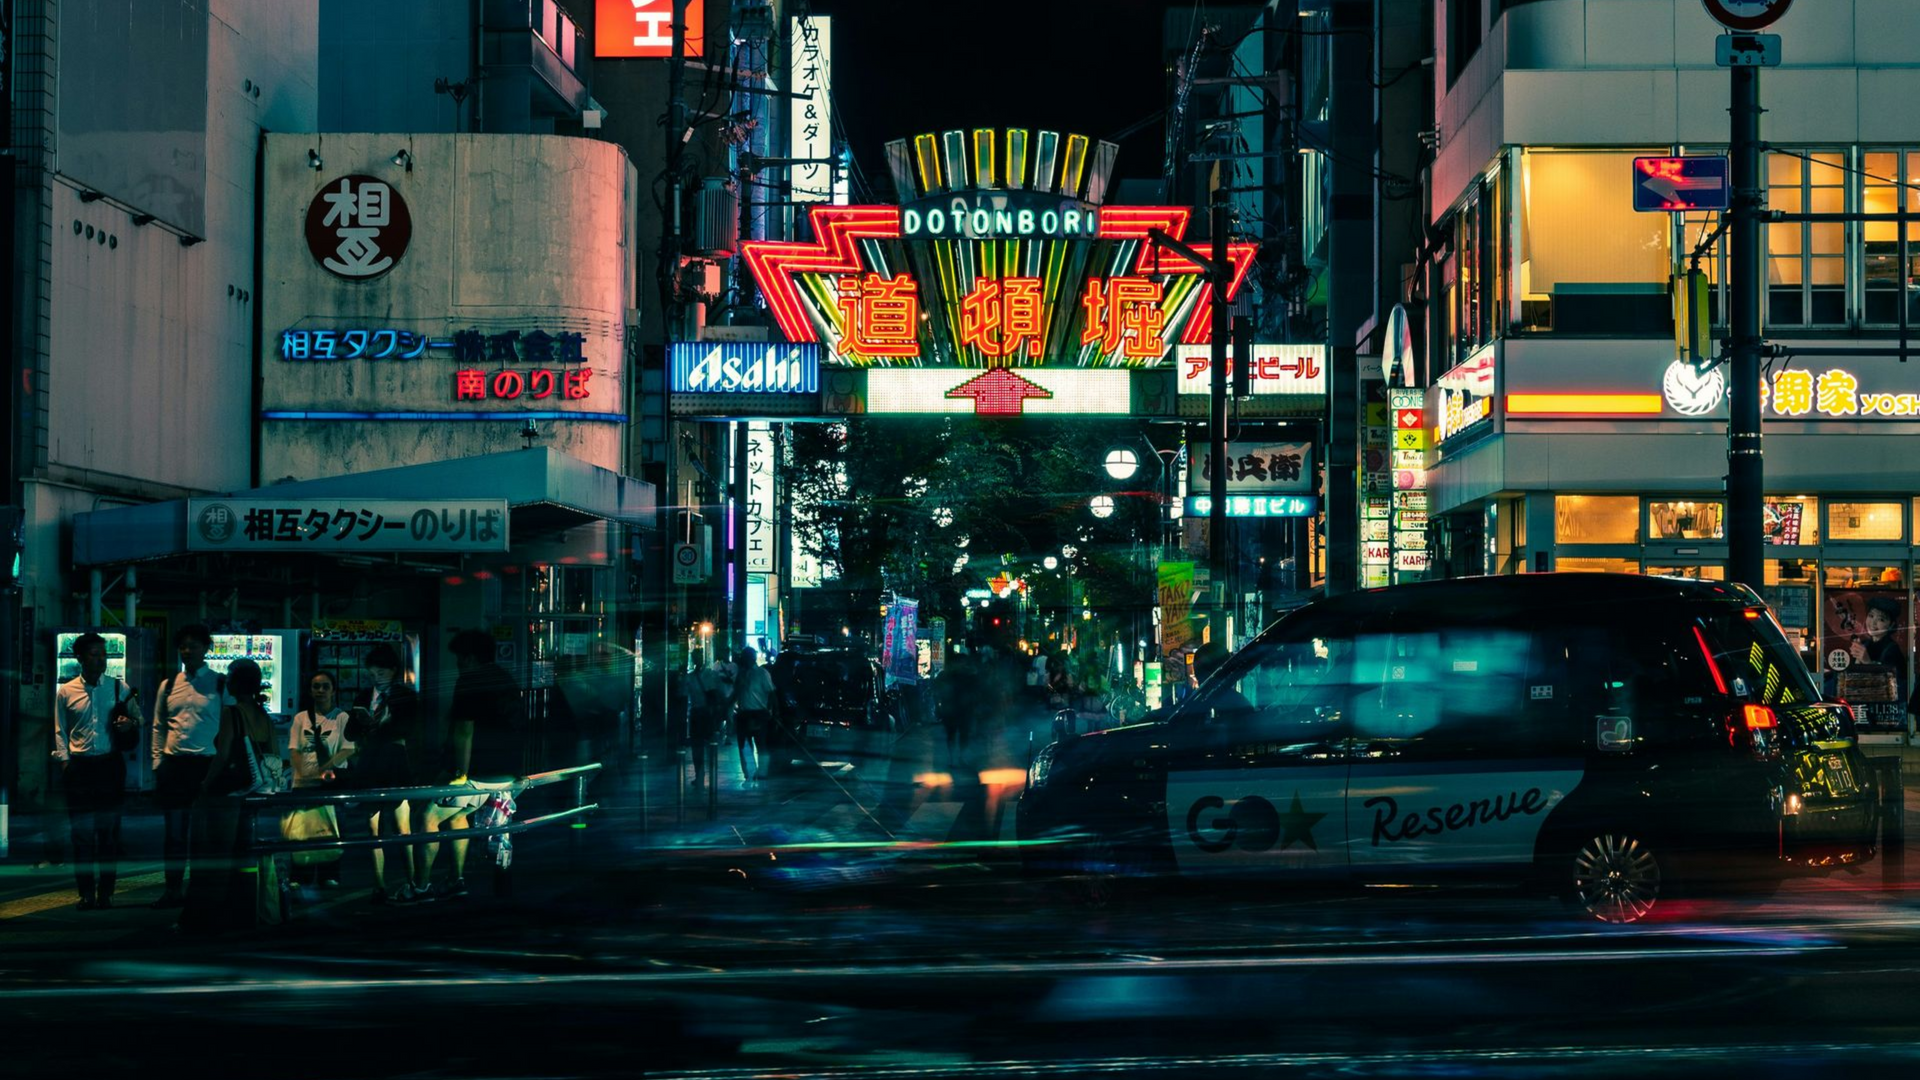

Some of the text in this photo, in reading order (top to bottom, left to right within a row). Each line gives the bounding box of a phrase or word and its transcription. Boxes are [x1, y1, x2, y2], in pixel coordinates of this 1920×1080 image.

[631, 0, 673, 46] ェ
[802, 25, 820, 181] カラオケ&ダーツ
[903, 207, 1094, 235] DOTONBORI
[837, 273, 1164, 358] 道頓堀
[456, 368, 593, 400] 南のりば
[688, 343, 801, 389] Asahi
[1185, 357, 1320, 380] アビール
[746, 439, 763, 551] ネットカフェ
[243, 507, 503, 542] 相互タクシーのりば
[682, 551, 693, 561] 30
[1187, 795, 1280, 853] GO
[1364, 786, 1549, 848] Reserve
